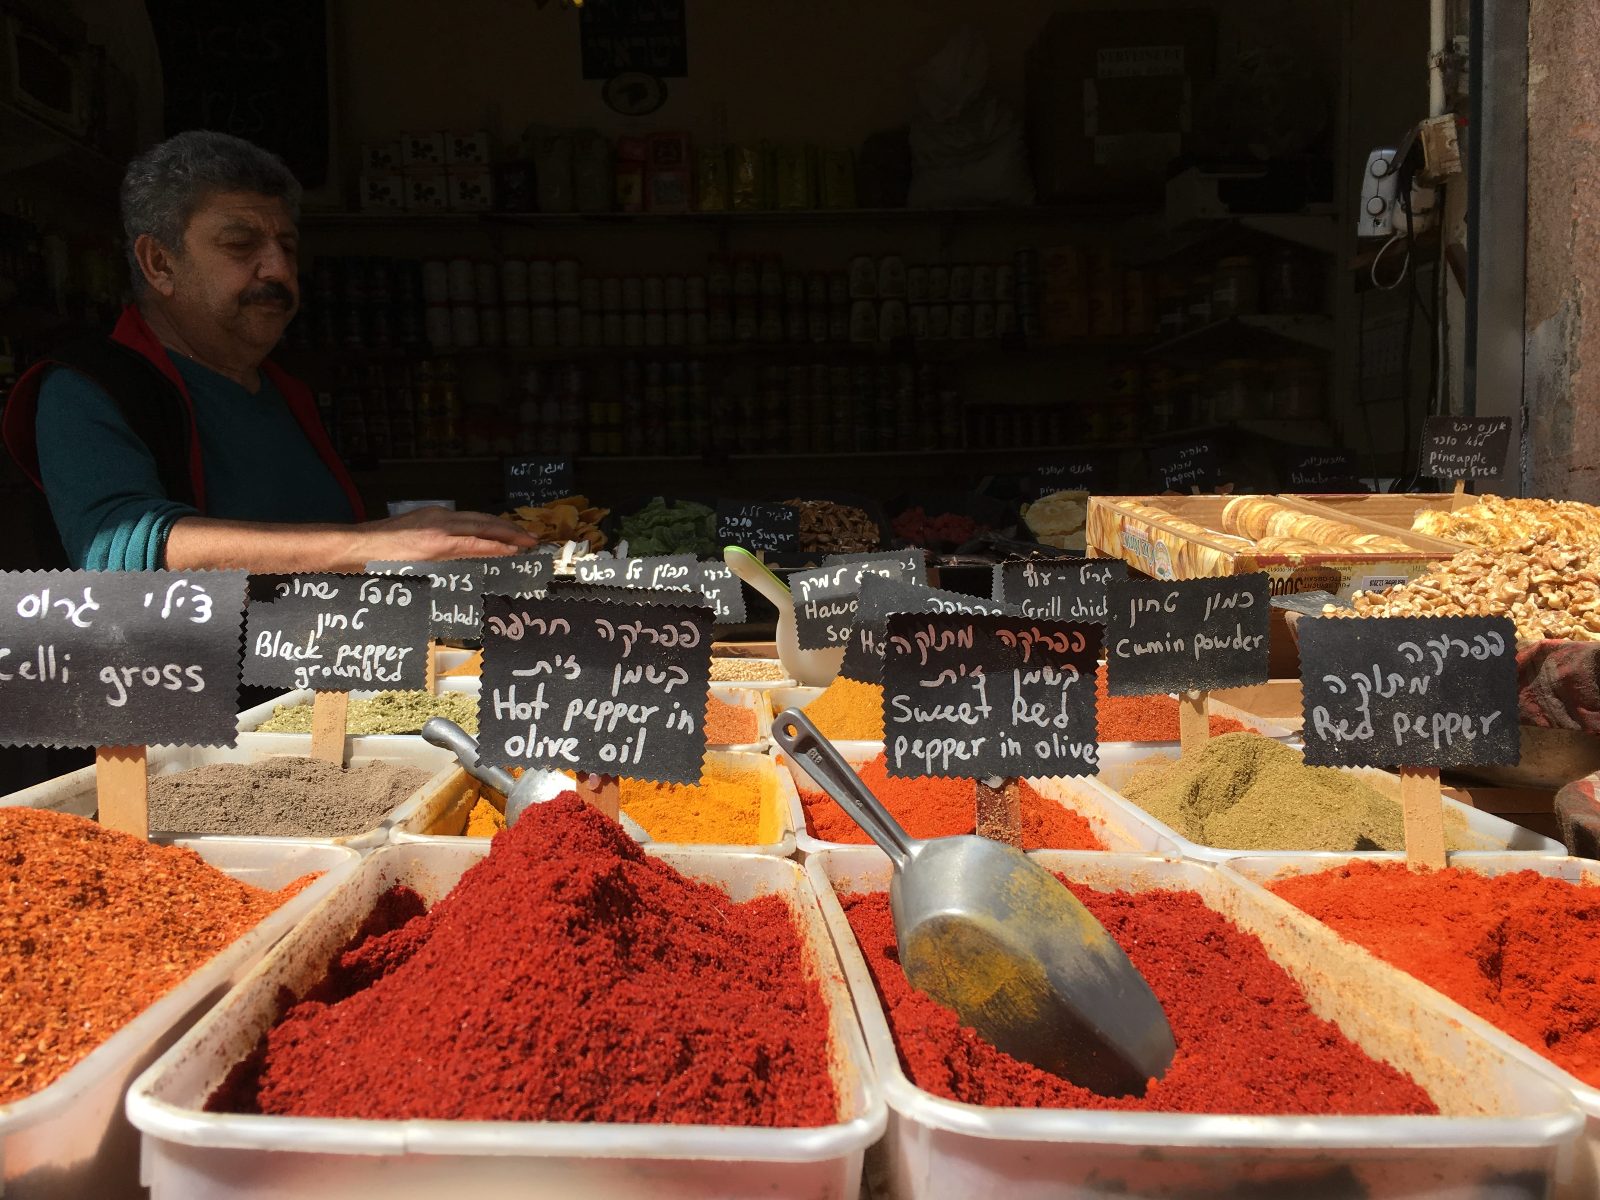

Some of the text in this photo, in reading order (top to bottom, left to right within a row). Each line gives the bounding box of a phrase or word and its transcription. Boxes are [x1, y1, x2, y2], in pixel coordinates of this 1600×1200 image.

[360, 577, 413, 606] פלפל
[1022, 595, 1061, 618] Grill
[1129, 590, 1255, 628] כמון טחון
[315, 608, 369, 638] טחון
[431, 600, 479, 627] baladi
[255, 630, 413, 670] Black pepper
[1194, 623, 1264, 661] powder
[100, 664, 206, 707] gross
[295, 661, 403, 689] grounded
[512, 654, 581, 680] זית
[493, 682, 695, 735] Hot pepper in
[891, 680, 993, 725] Sweet
[504, 723, 648, 764] olive oil
[1312, 704, 1502, 750] Red pepper
[894, 731, 1098, 774] pepper in olive
